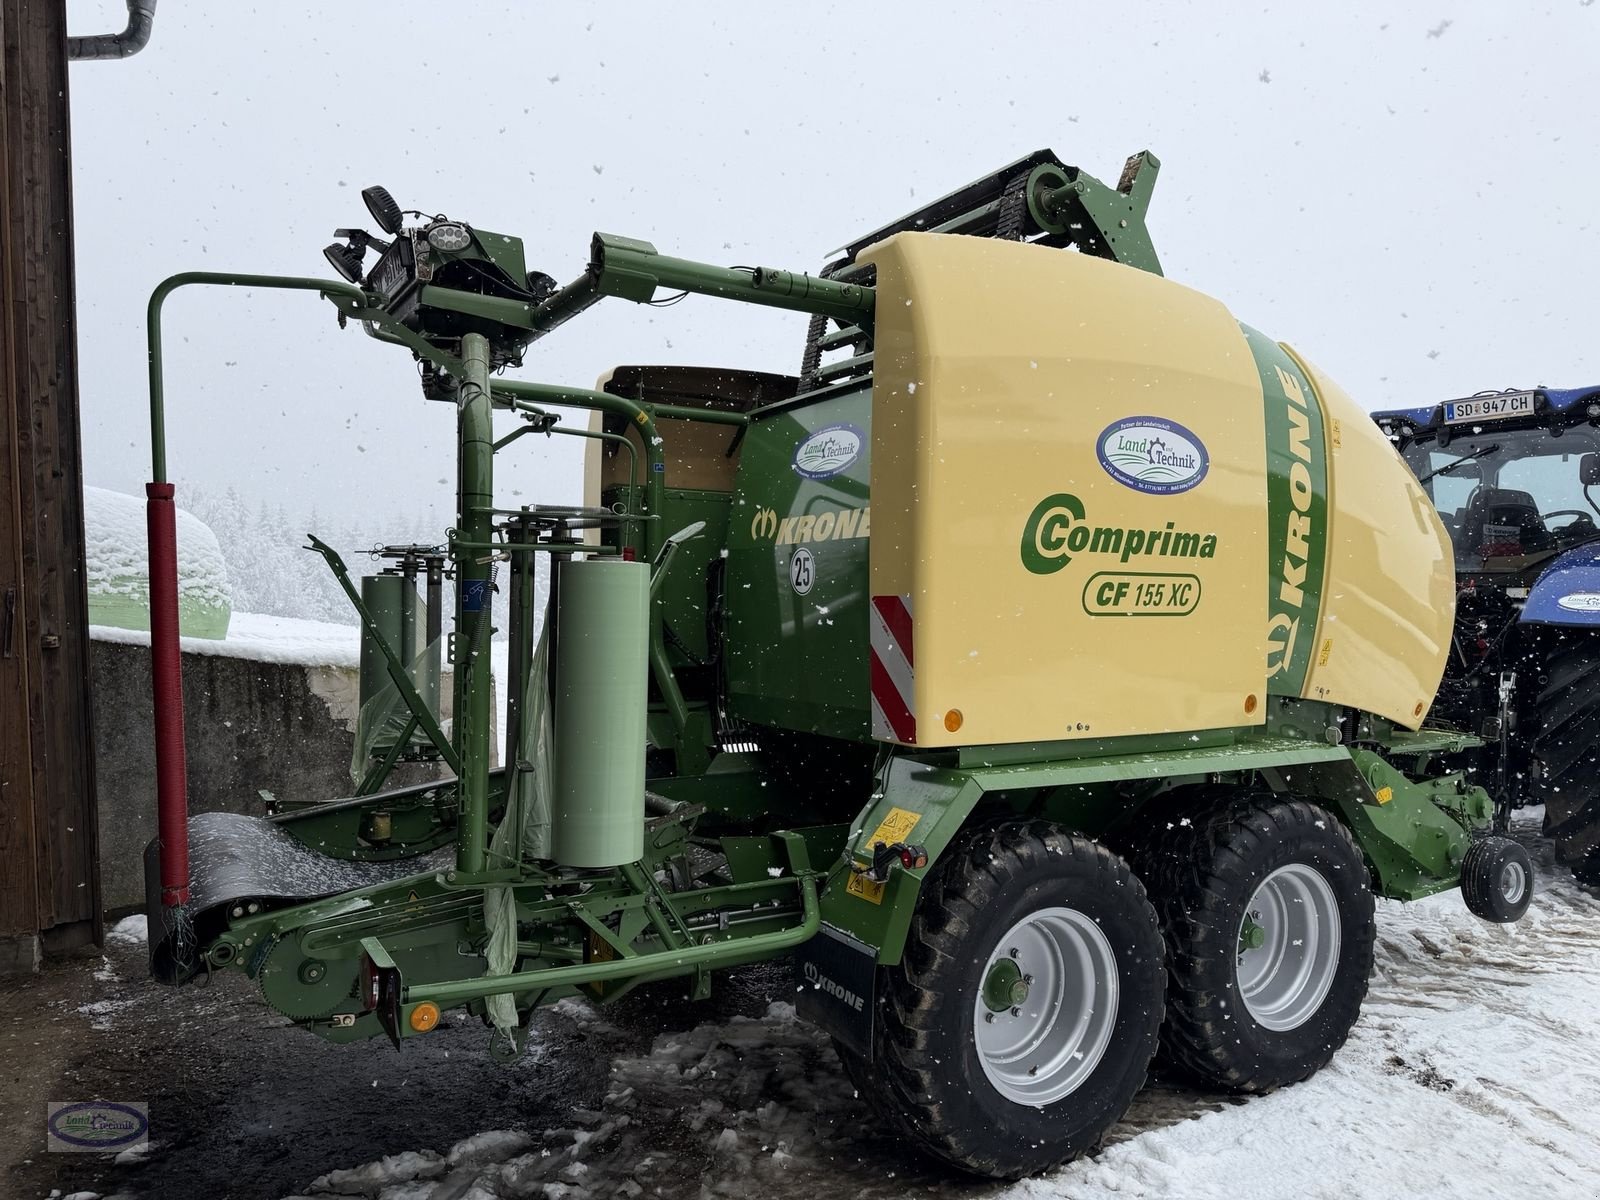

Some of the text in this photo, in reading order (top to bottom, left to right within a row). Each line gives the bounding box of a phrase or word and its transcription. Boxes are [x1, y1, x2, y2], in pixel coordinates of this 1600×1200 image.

[1457, 404, 1472, 417] SD
[1483, 399, 1507, 413] 947
[1511, 396, 1528, 409] CH
[804, 441, 823, 455] Land
[827, 443, 855, 457] Technik
[1117, 435, 1147, 454] Land
[1156, 450, 1195, 470] Technik
[1273, 364, 1312, 609] KRONE
[795, 557, 810, 587] 25
[1096, 582, 1192, 606] CF 155 XC
[818, 974, 864, 1012] KRONE
